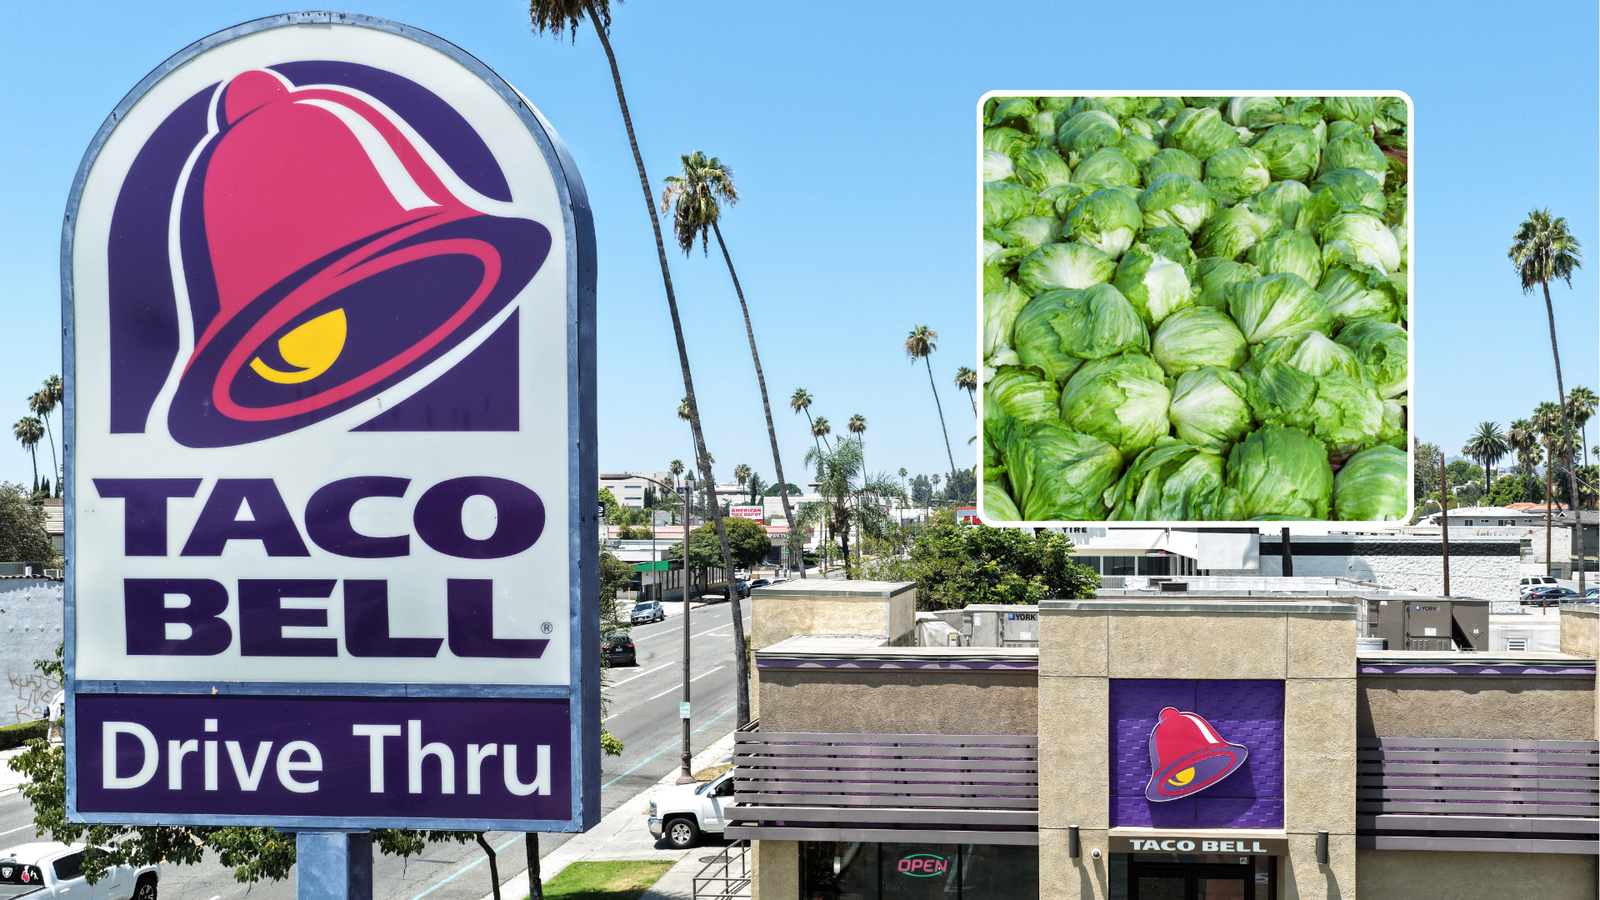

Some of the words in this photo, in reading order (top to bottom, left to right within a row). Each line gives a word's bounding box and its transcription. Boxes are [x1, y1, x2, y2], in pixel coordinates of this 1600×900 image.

[92, 475, 546, 559] TACO
[124, 578, 550, 659] BELL
[102, 719, 323, 793] Drive
[352, 719, 551, 796] Thru
[897, 859, 948, 872] OPEN
[1129, 839, 1196, 852] TACO
[1202, 840, 1267, 852] BELL
